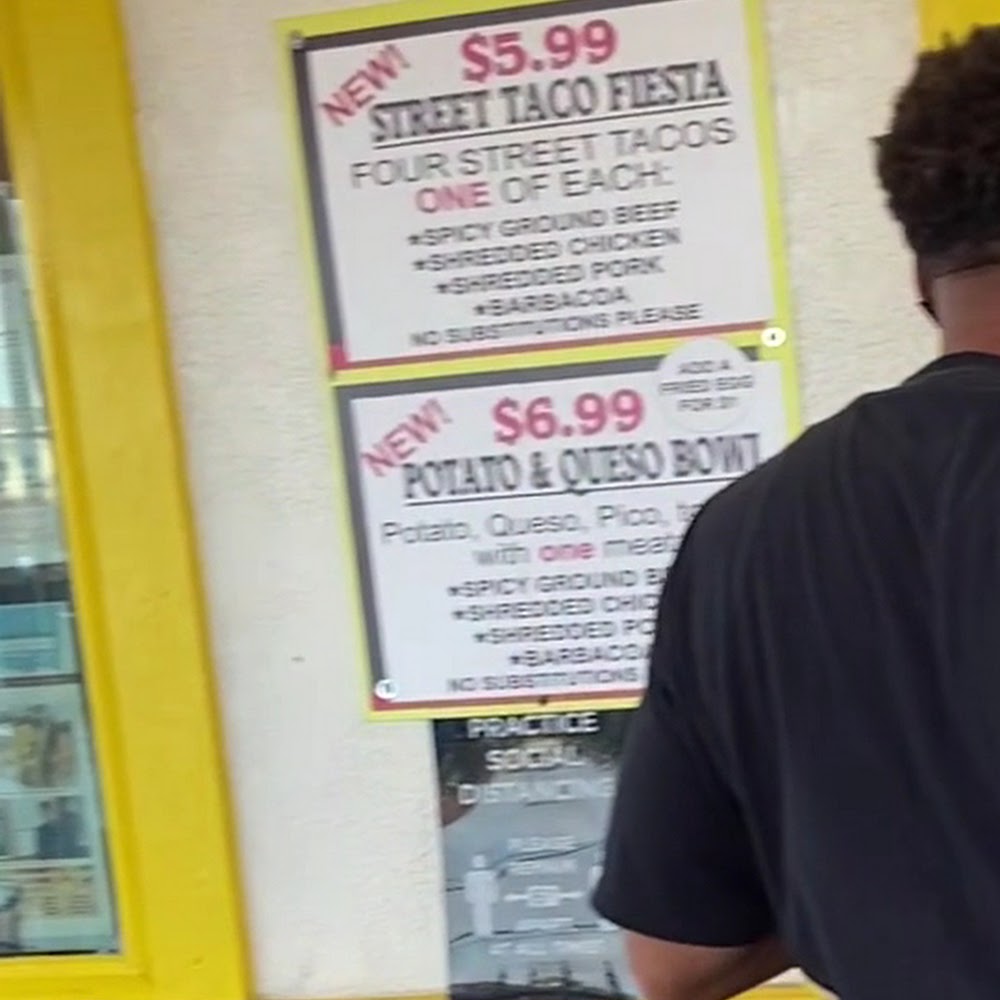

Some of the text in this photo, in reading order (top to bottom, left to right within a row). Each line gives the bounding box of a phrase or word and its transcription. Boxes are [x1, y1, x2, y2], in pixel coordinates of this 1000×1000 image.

[460, 18, 617, 83] $5.99
[322, 44, 411, 126] NEW!
[370, 59, 730, 142] STREET TACO FIESTA
[352, 116, 736, 188] FOUR STREET TACOS
[416, 162, 674, 213] ONE OF EACH:
[424, 199, 680, 246] SPICY GROUND BEEF
[428, 227, 682, 272] SHREDDED CHICKEN
[451, 255, 665, 295] SHREDDED PORK
[410, 302, 703, 345] NO SUBSTITUTIONS PLEASE
[488, 286, 630, 317] BARBACOA
[363, 396, 452, 477] NEW!
[493, 387, 644, 446] $6.99
[402, 453, 522, 499] POTATO
[529, 451, 553, 489] &
[559, 441, 665, 496] QUESO
[381, 519, 479, 545] Potato,
[486, 512, 590, 537] Queso,
[473, 542, 530, 566] with
[539, 541, 597, 563] one
[535, 570, 639, 593] GROUND
[468, 593, 659, 620] SHREDDED CHIC
[490, 618, 657, 644] SHREDDED PO
[448, 666, 637, 692] NO SUBSTITUTIONS
[466, 712, 600, 739] PRACTICE
